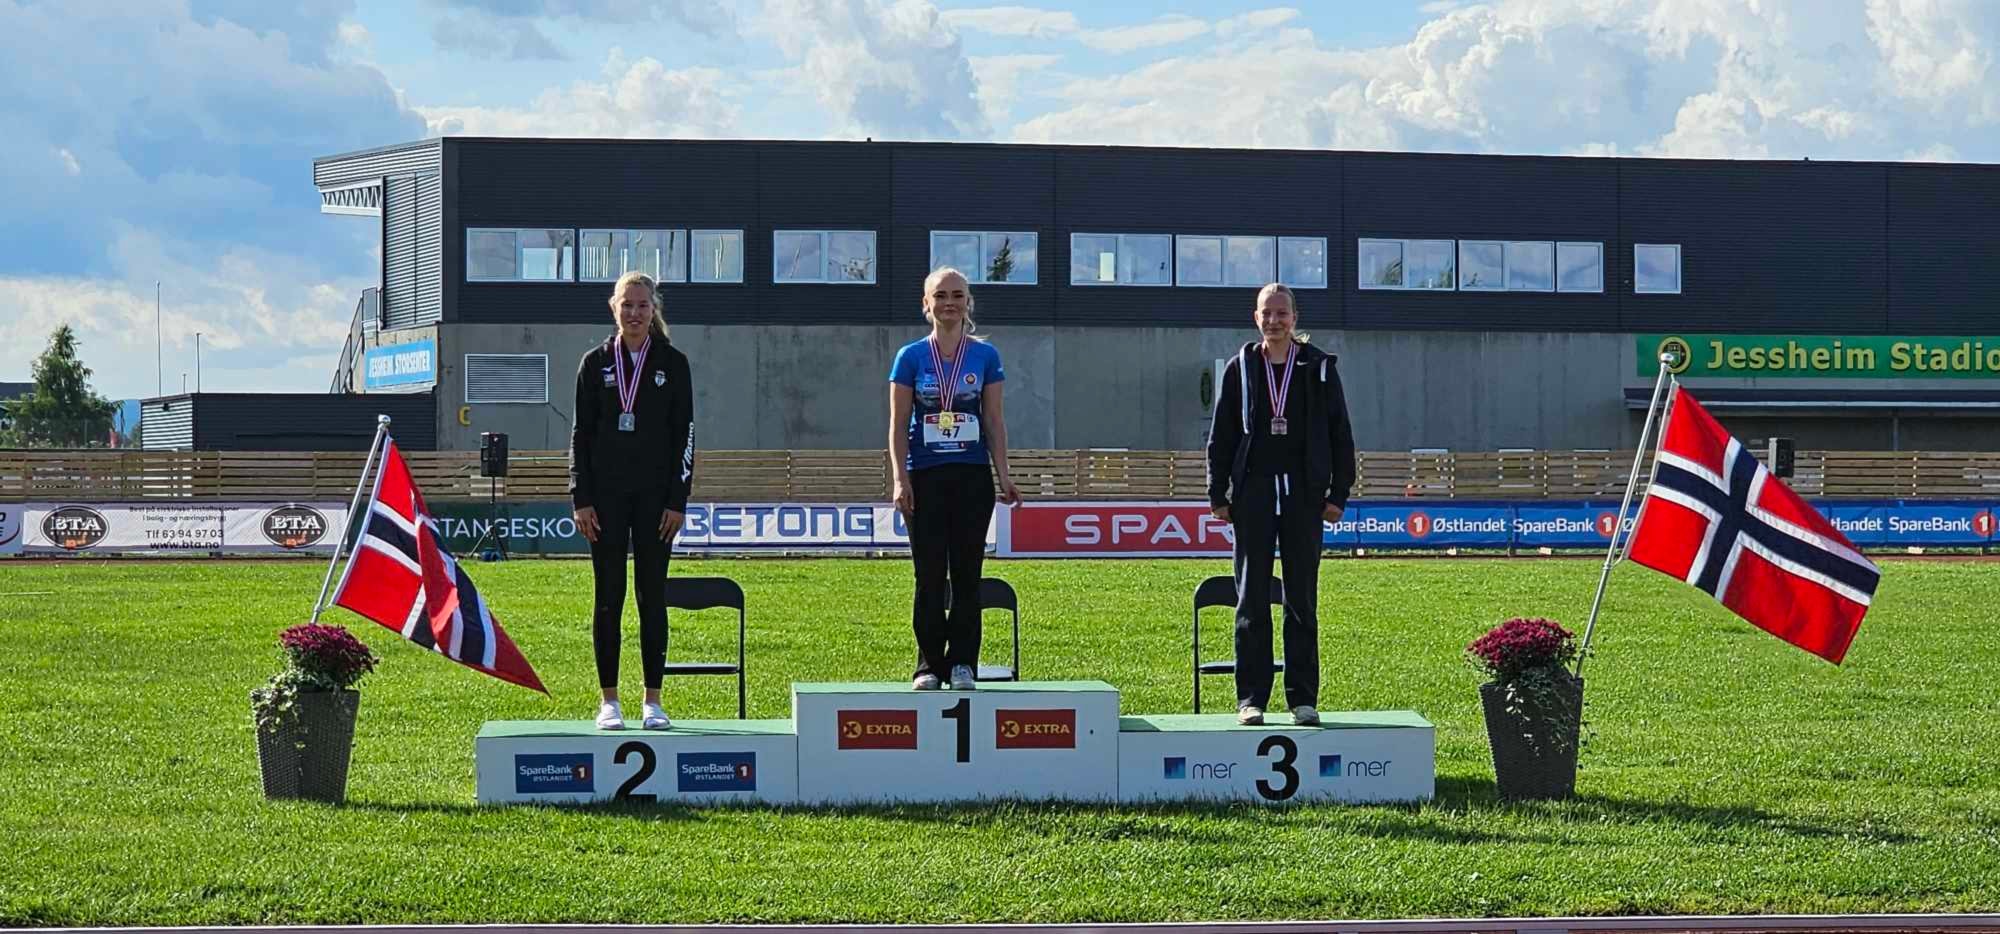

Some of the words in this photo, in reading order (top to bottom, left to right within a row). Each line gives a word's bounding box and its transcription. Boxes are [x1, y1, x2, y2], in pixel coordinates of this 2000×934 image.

[1707, 340, 1875, 369] Jessheim
[1890, 341, 2000, 370] Stadio
[942, 425, 961, 439] 47
[50, 516, 102, 530] BTA
[270, 515, 322, 529] BTA
[680, 506, 872, 537] BETONG
[1065, 514, 1234, 544] SPAR
[1323, 518, 1405, 535] SpareBank
[1433, 518, 1506, 532] Østlandet
[1513, 518, 1594, 535] SpareBank
[1831, 517, 1883, 531] tlandet
[1889, 516, 1971, 534] SpareBank
[145, 529, 160, 538] Tlf
[162, 529, 176, 538] 63
[178, 529, 192, 538] 94
[195, 529, 208, 538] 97
[210, 529, 224, 538] 03
[150, 540, 220, 549] www.bta.no
[866, 724, 912, 735] EXTRA
[942, 698, 970, 762] 1
[1024, 723, 1070, 734] EXTRA
[519, 764, 573, 776] SpareBank
[614, 741, 657, 801] 2
[682, 764, 735, 775] SpareBank
[1192, 762, 1238, 780] mer
[1256, 735, 1299, 800] 3
[1347, 760, 1392, 777] mer
